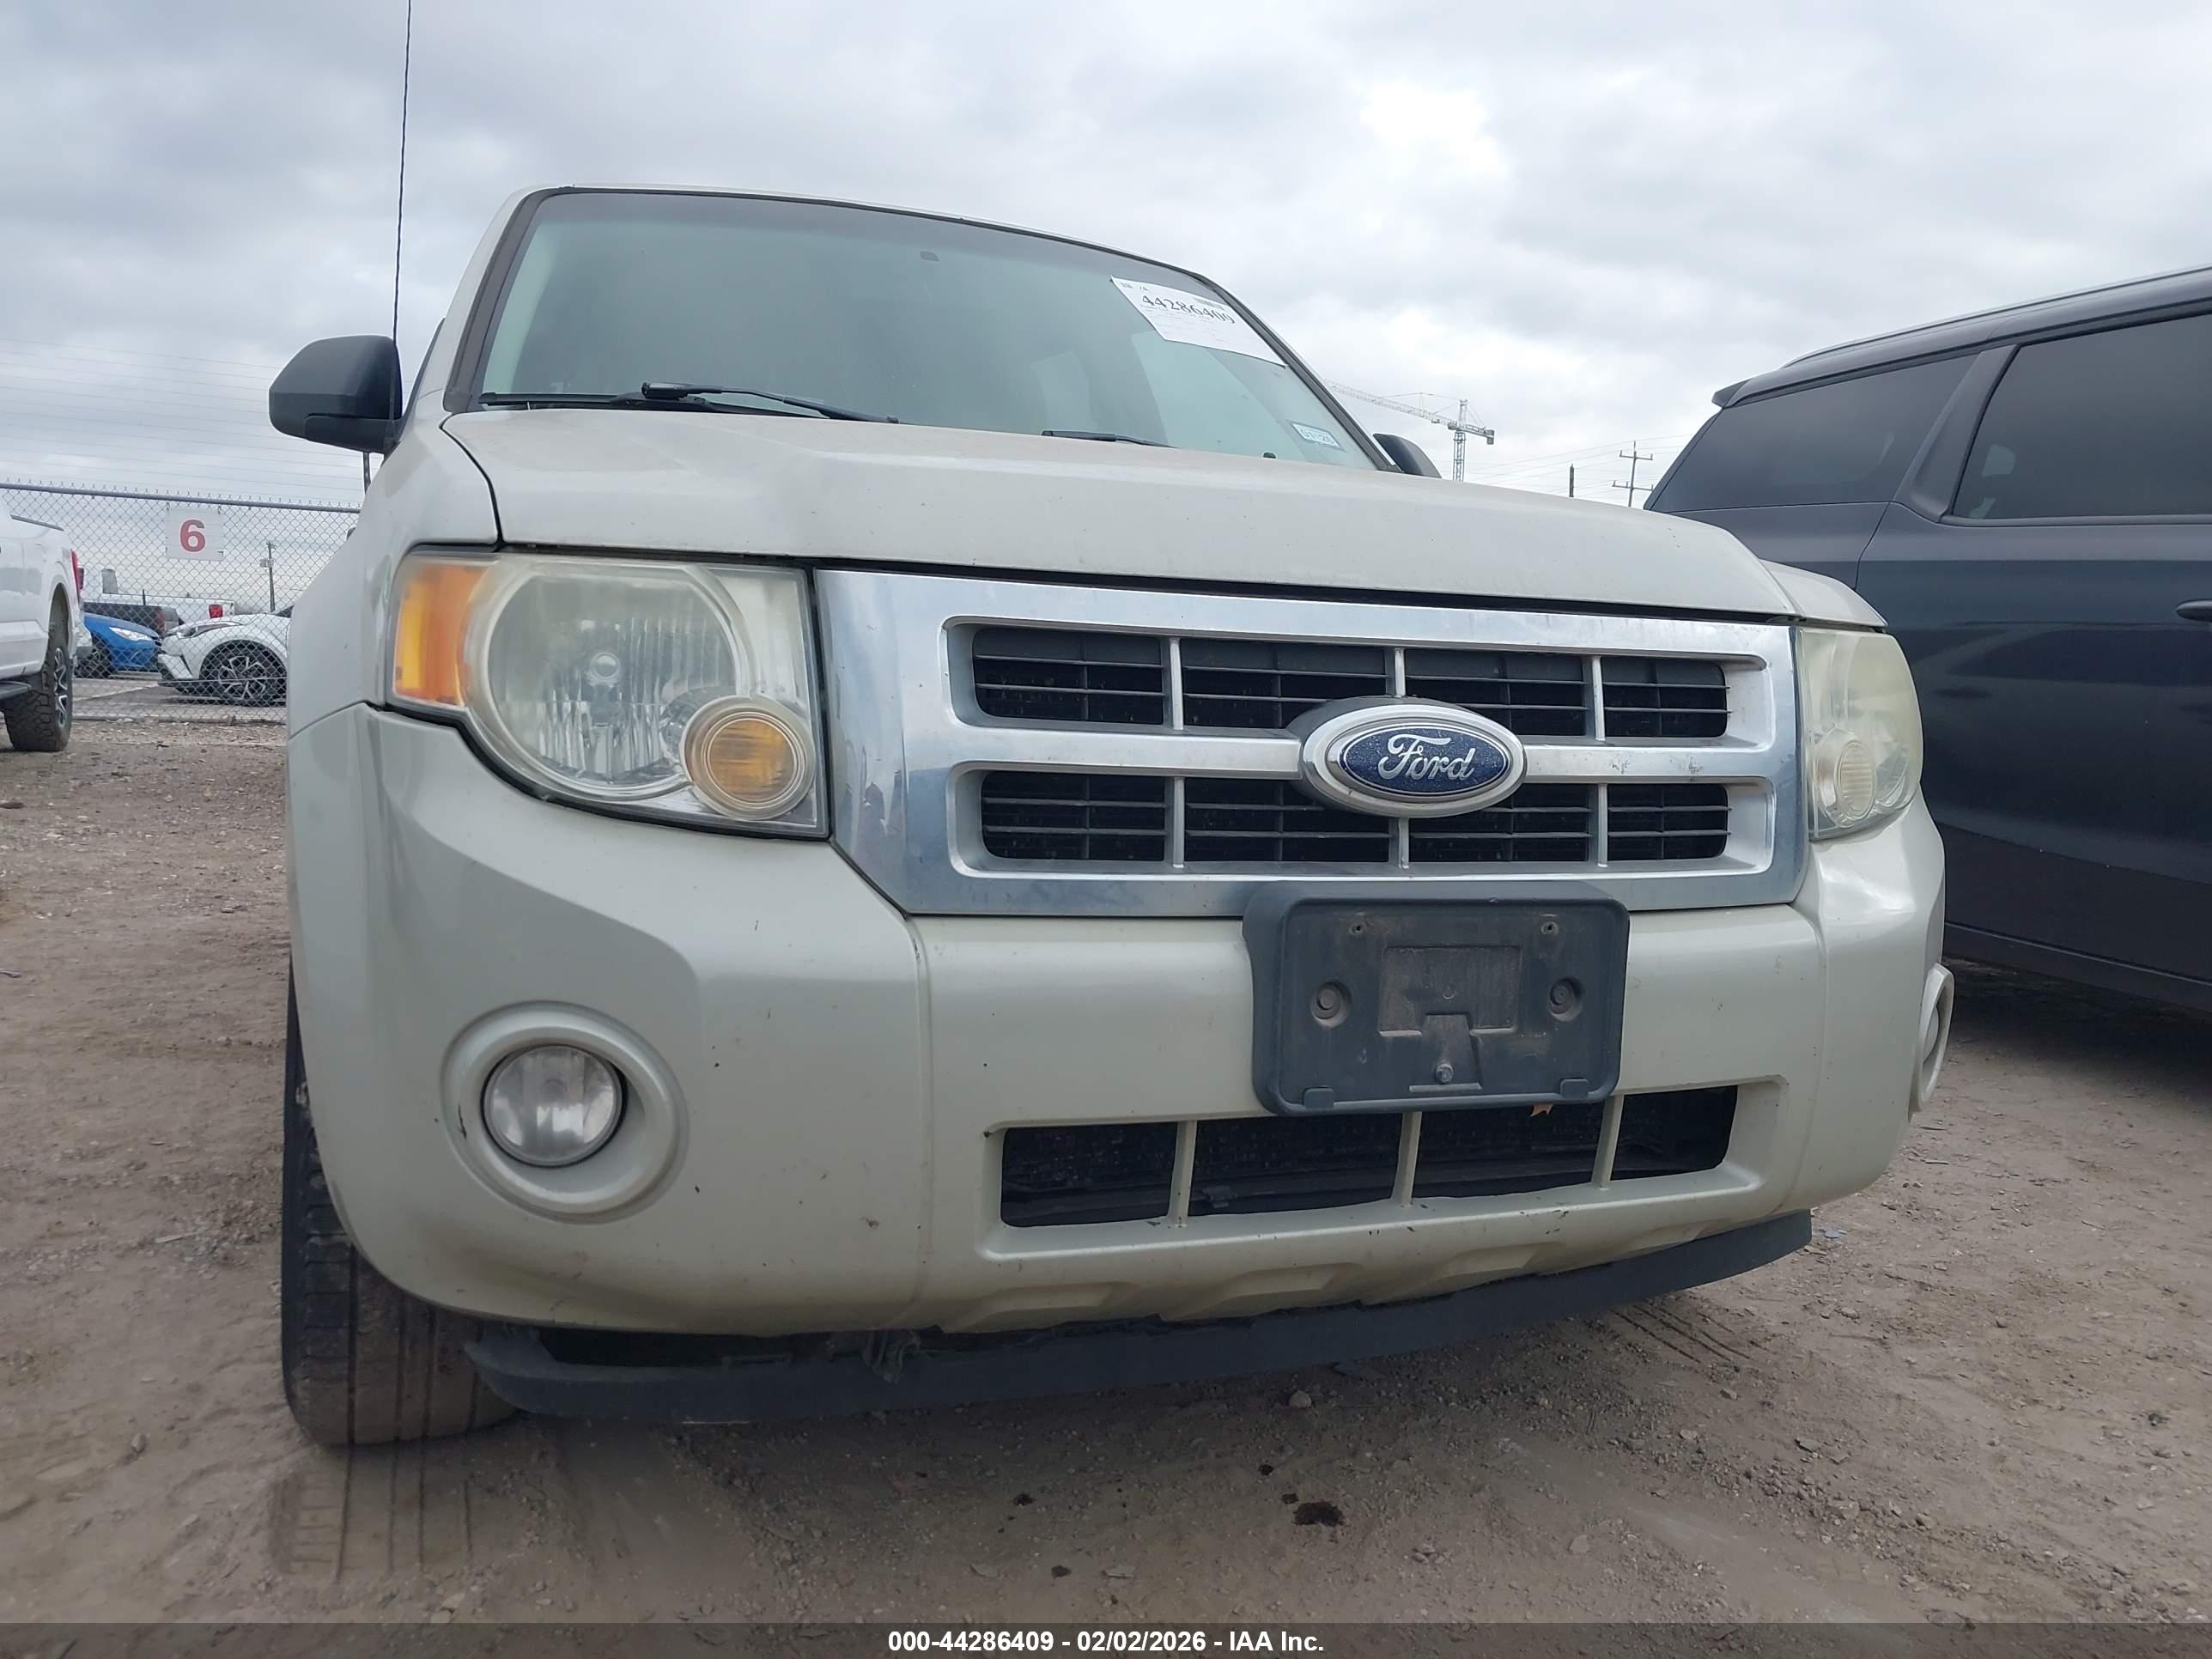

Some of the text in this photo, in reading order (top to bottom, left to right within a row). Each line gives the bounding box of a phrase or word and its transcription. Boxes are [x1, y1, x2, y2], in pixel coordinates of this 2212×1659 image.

[1142, 295, 1236, 325] 44286409
[180, 520, 205, 552] 6
[1377, 733, 1476, 781] Ford
